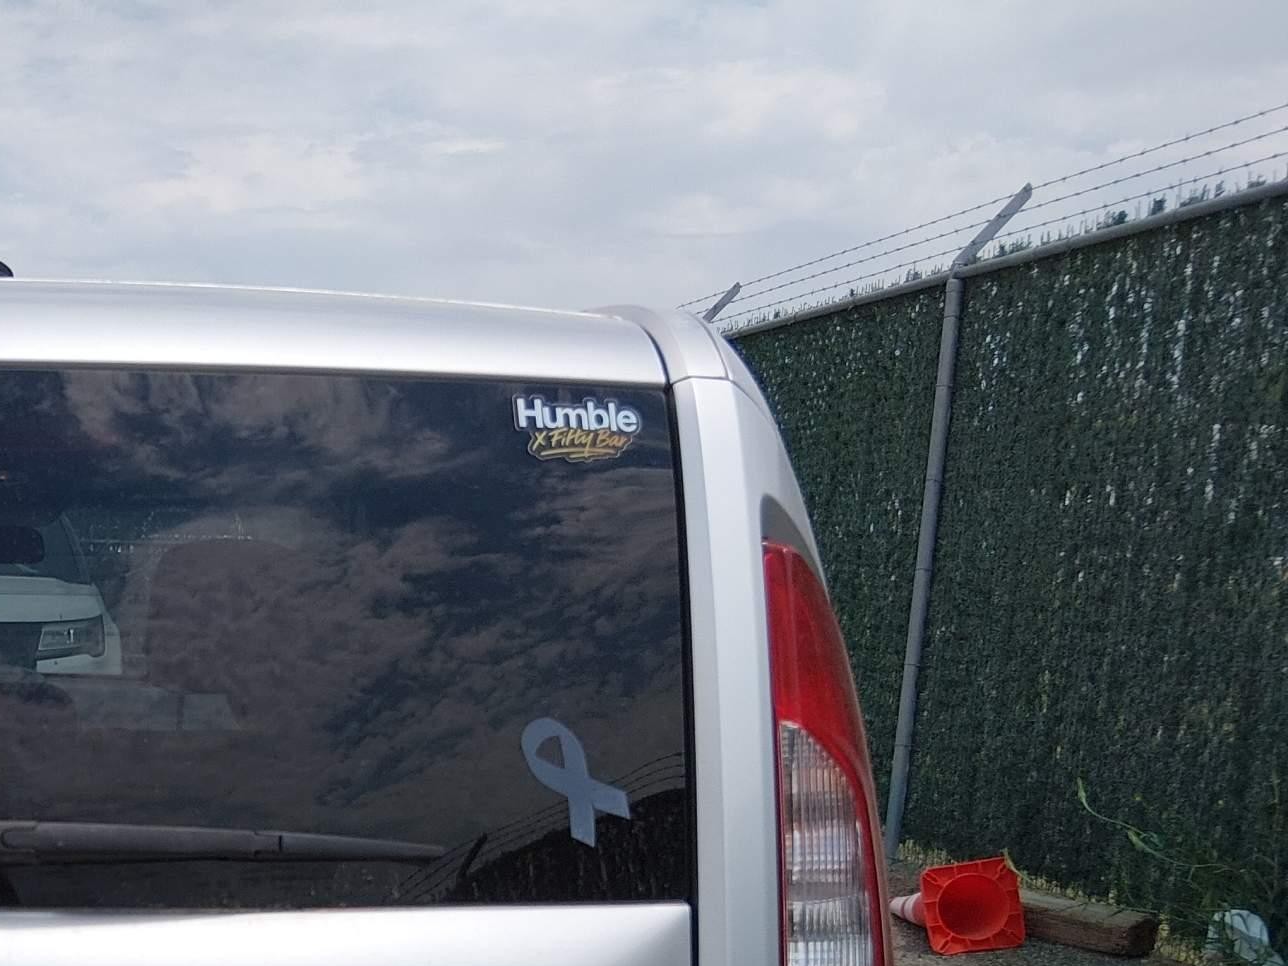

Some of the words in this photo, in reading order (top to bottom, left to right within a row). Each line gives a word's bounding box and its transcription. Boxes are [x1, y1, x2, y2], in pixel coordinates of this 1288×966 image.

[516, 397, 638, 433] Humble
[548, 427, 594, 458] Fifty
[595, 429, 628, 448] Bar
